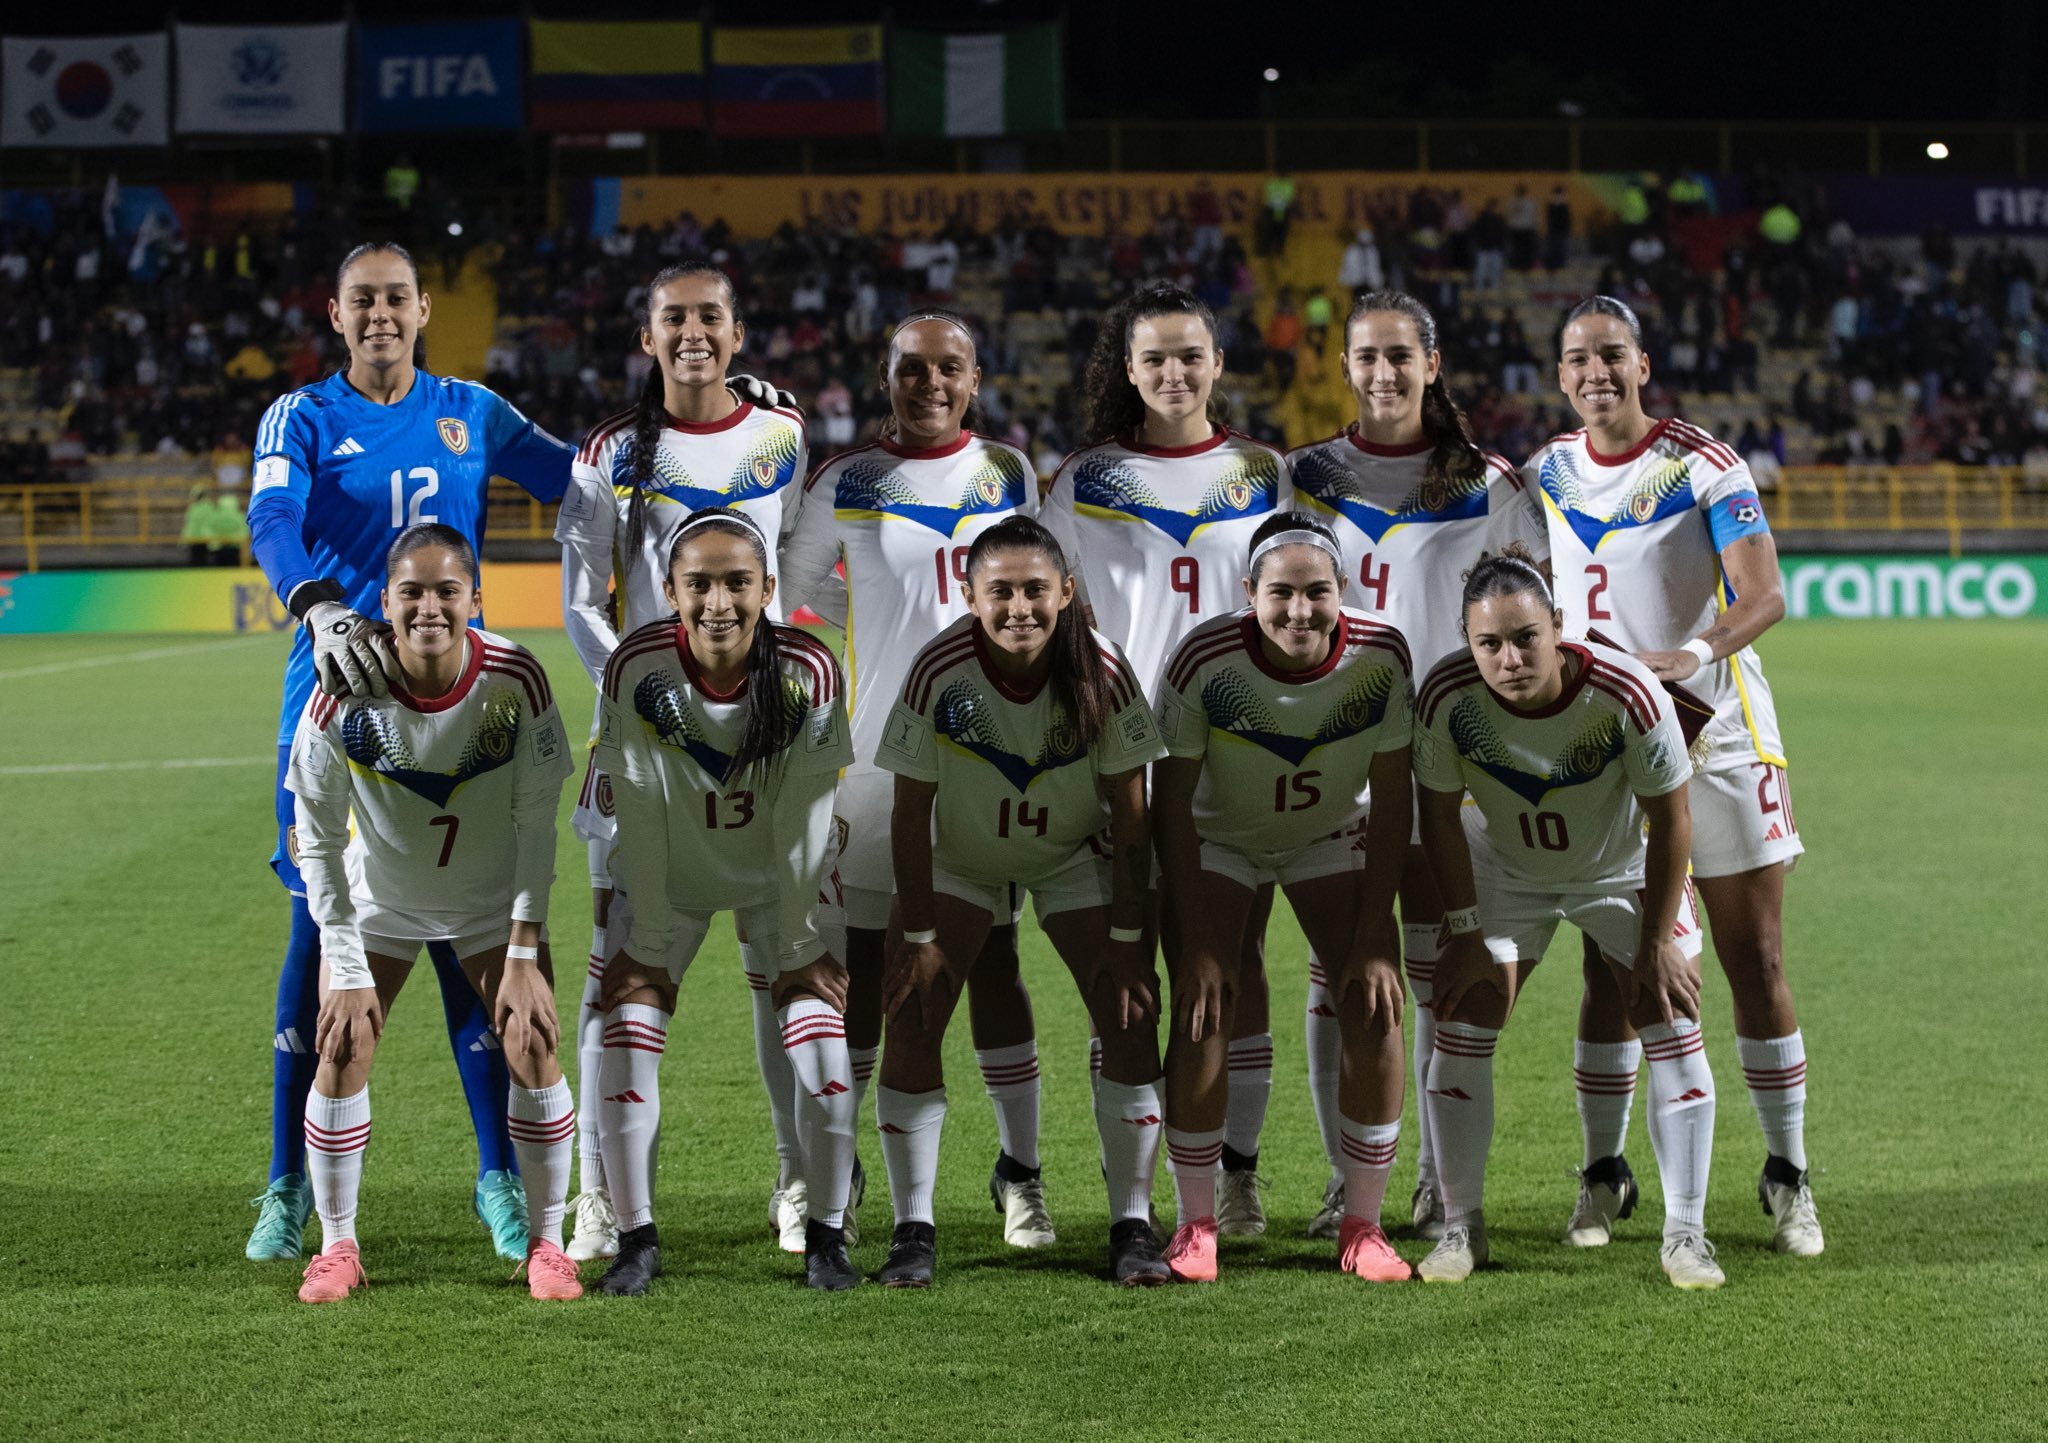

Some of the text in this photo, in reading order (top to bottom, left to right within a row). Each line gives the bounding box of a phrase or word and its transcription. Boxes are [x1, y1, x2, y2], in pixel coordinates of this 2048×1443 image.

[379, 54, 498, 98] FIFA
[1975, 187, 2048, 226] FIF
[390, 466, 440, 528] 12
[1171, 556, 1199, 614] 9
[1360, 552, 1390, 610] 4
[1584, 564, 1611, 621] 2
[1780, 562, 2037, 619] ramco
[706, 790, 754, 830] 13
[1275, 770, 1322, 812] 15
[1751, 762, 1779, 815] 2
[429, 815, 460, 868] 7
[998, 797, 1048, 838] 14
[1519, 811, 1570, 851] 10
